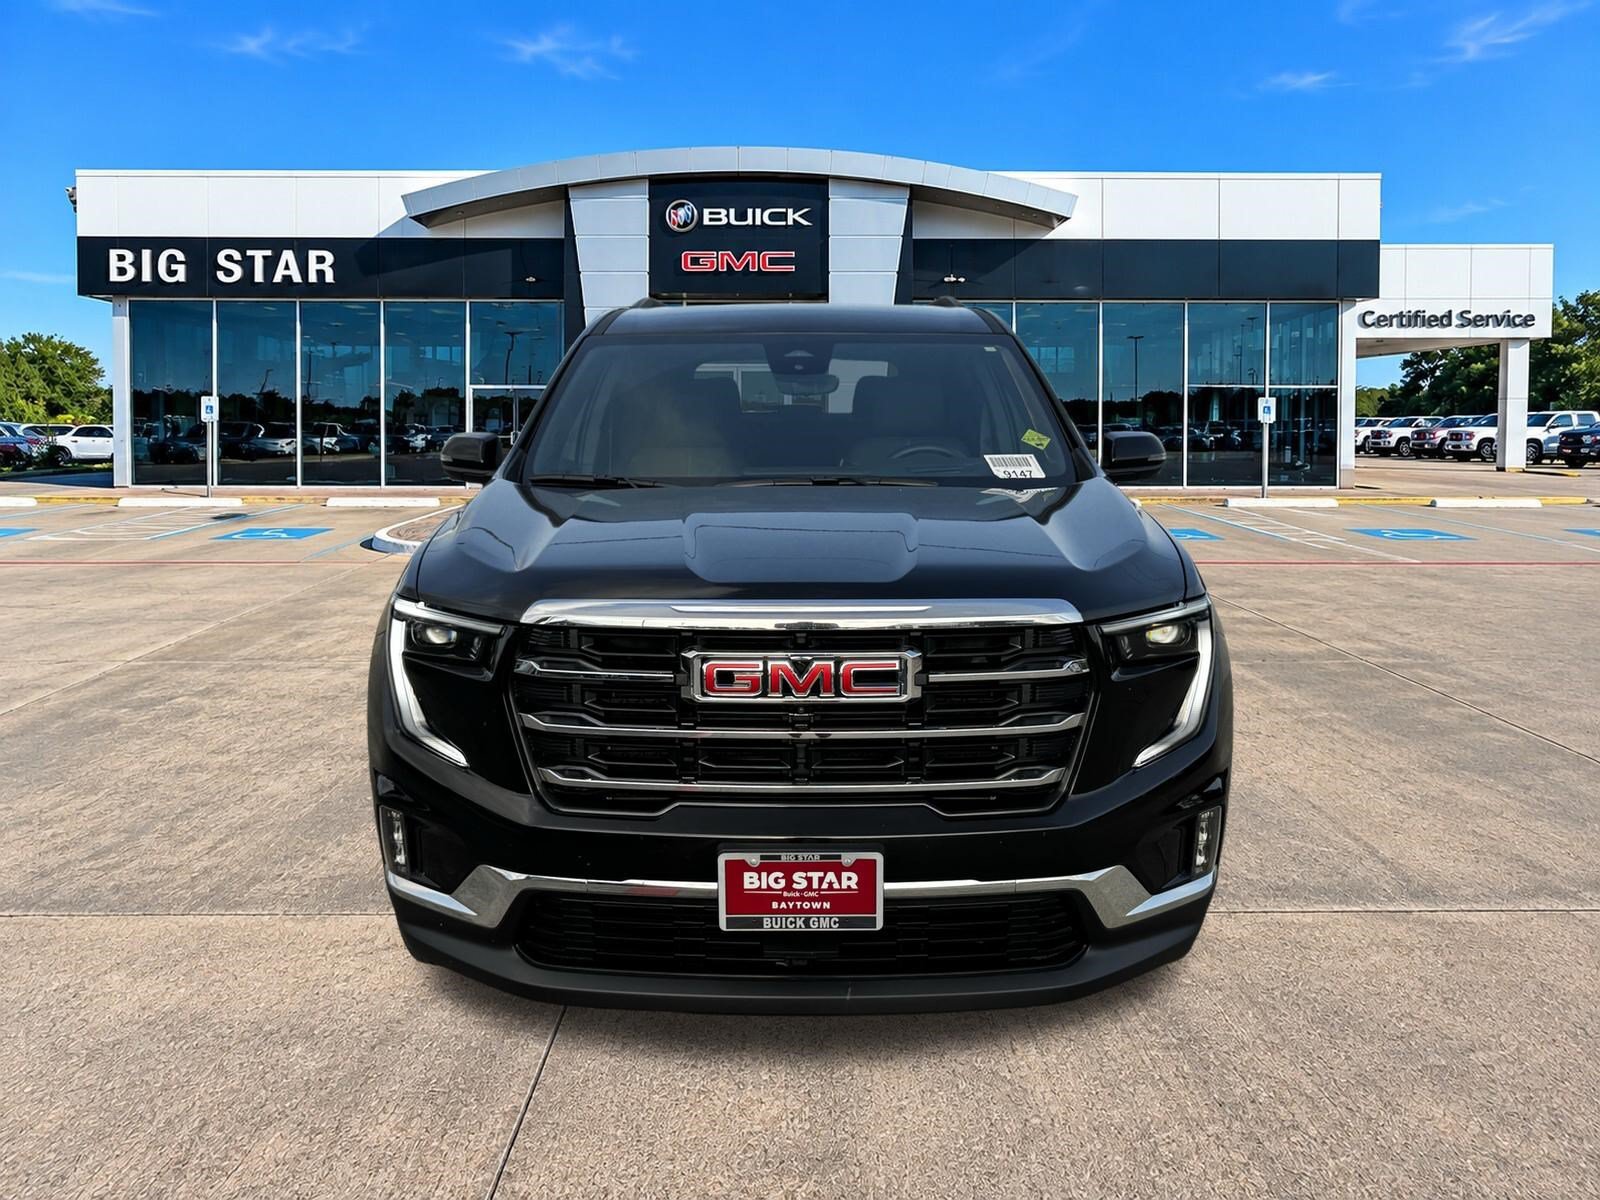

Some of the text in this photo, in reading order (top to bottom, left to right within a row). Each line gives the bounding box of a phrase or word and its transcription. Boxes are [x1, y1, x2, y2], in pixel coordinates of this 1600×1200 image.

[703, 207, 813, 226] BUICK
[109, 248, 336, 283] BIG STAR
[681, 250, 796, 272] GMC
[1360, 309, 1536, 328] Certified Service
[1003, 470, 1033, 479] 9147
[702, 659, 900, 697] GMC
[743, 871, 859, 889] BIG STAR
[771, 901, 831, 910] BAYTOWN
[762, 917, 840, 929] BUICK GMC
